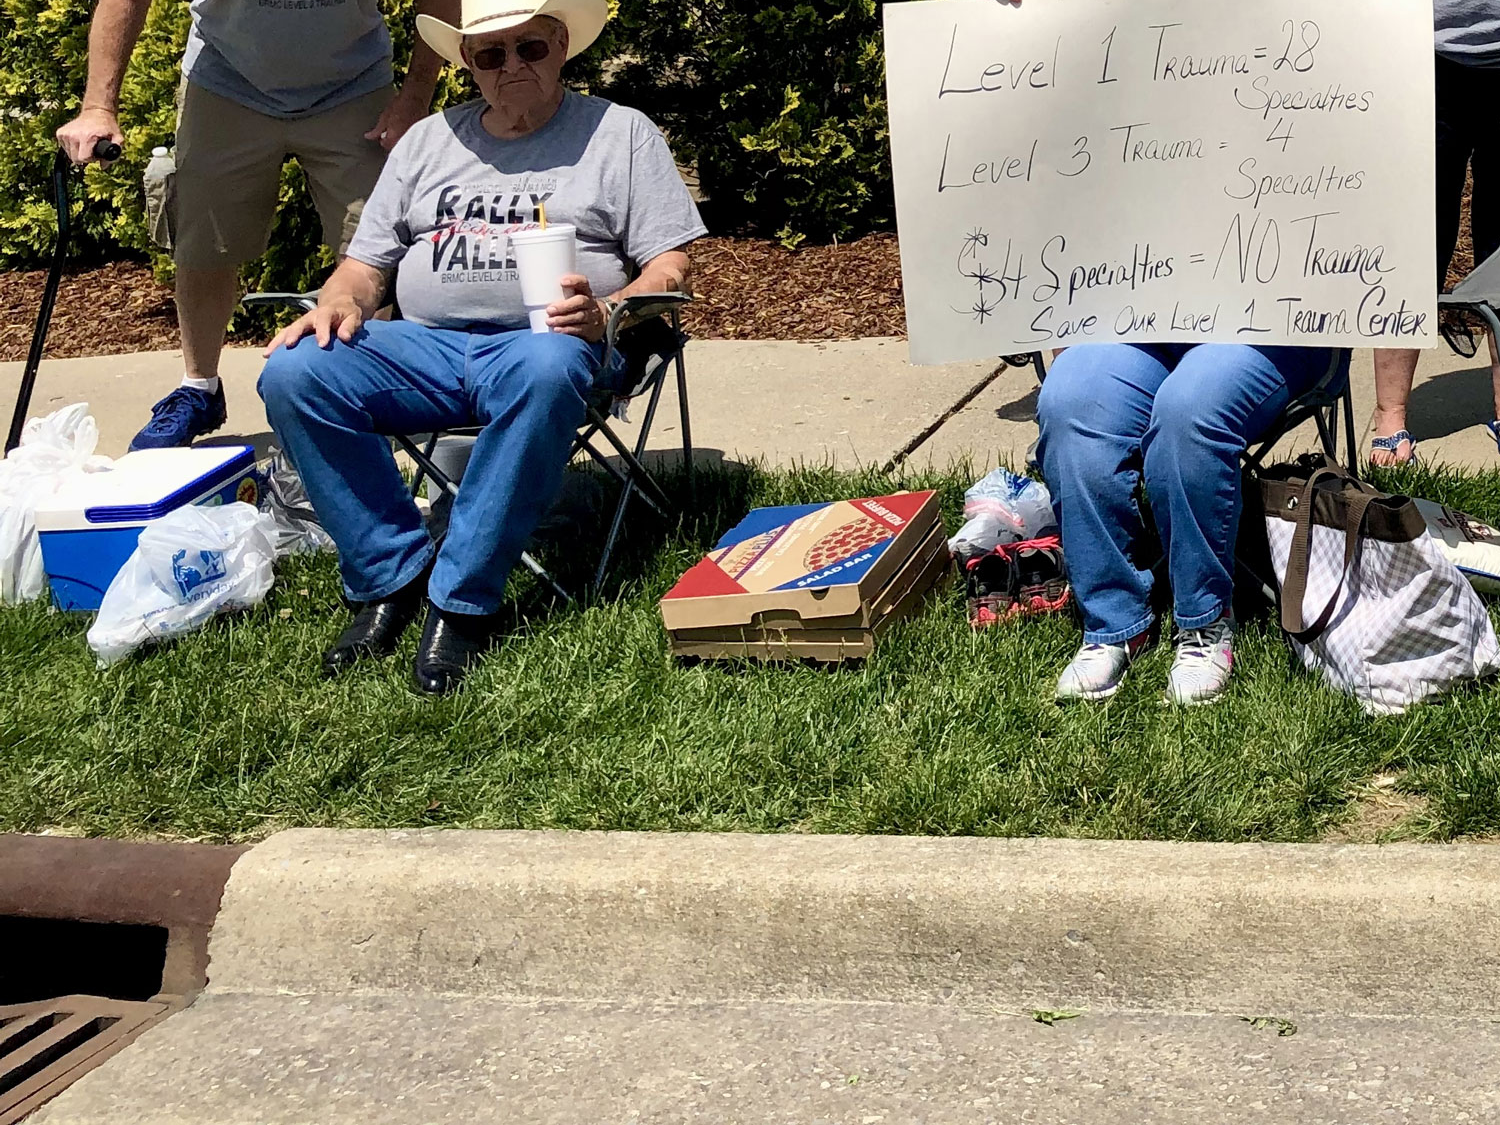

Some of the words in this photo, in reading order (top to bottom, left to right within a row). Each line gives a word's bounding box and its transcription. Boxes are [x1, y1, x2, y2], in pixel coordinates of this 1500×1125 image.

[939, 24, 1060, 99] Level
[1097, 25, 1118, 85] 1
[1234, 75, 1375, 120] Specialties
[938, 134, 1038, 192] Level
[1057, 136, 1091, 177] 3
[1265, 117, 1295, 153] 4
[1224, 157, 1366, 209] Specialties
[435, 185, 554, 230] RALLY
[432, 228, 517, 273] VALLE
[1033, 235, 1174, 305] Specialties
[1189, 251, 1207, 265] =
[1213, 212, 1281, 284] NO
[467, 271, 494, 282] LEVEL
[496, 270, 502, 281] 2
[1014, 302, 1097, 344] Save
[1170, 302, 1219, 334] Level
[1237, 299, 1272, 335] 1
[728, 551, 757, 574] PIZZA
[797, 565, 844, 587] SALAD
[844, 553, 873, 569] BAR
